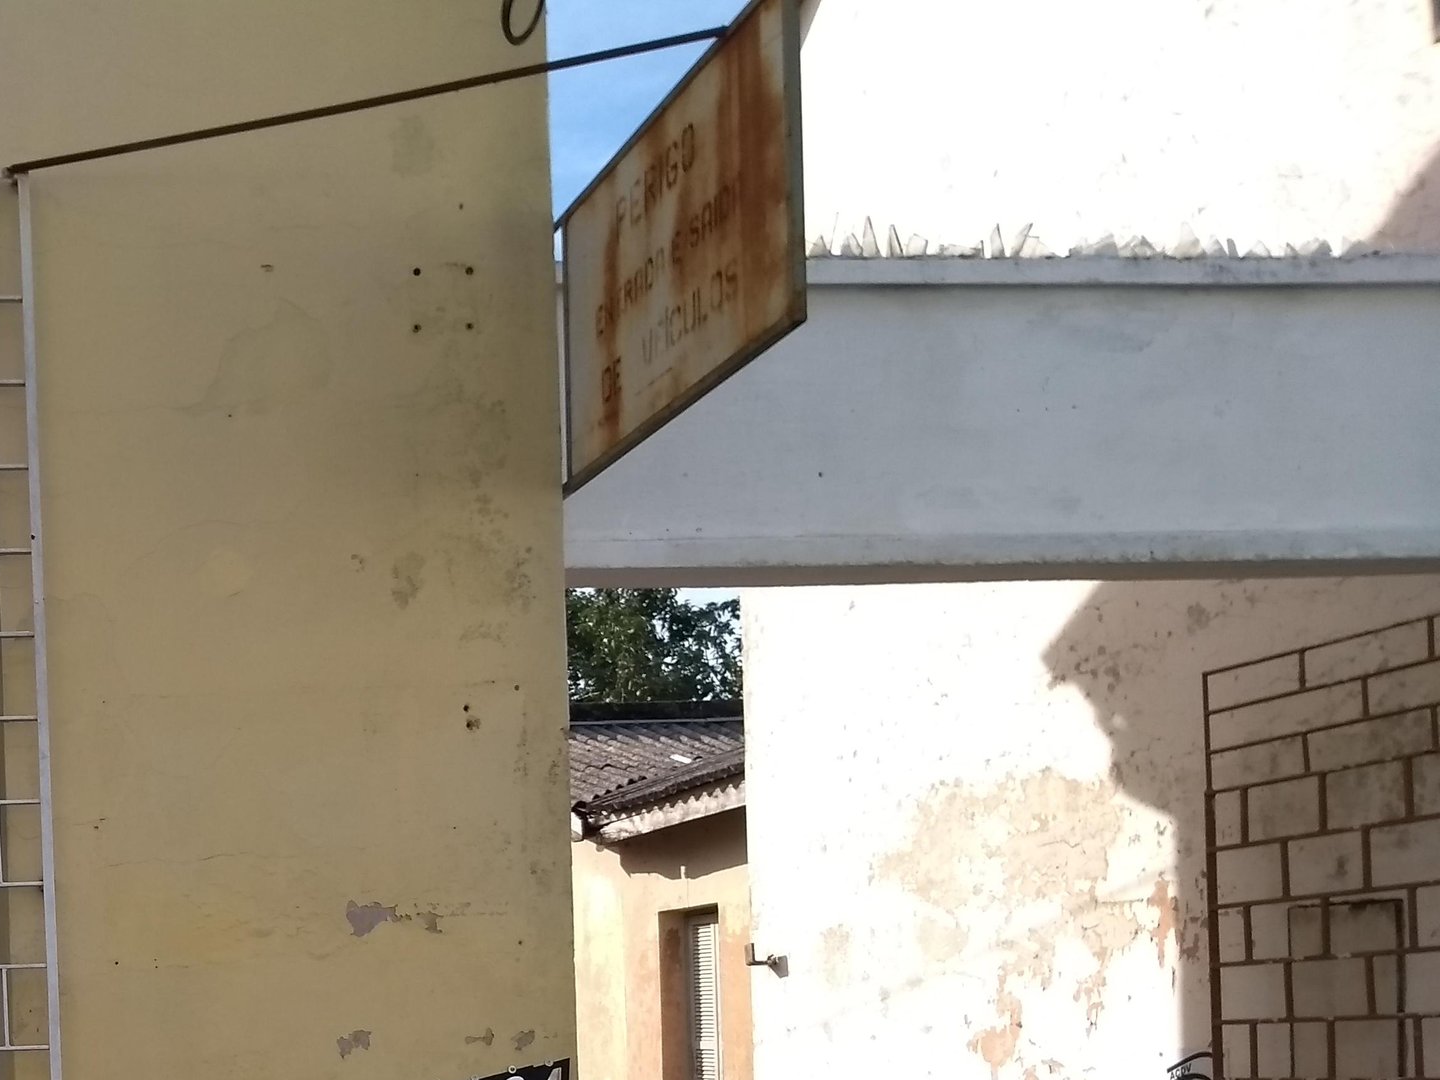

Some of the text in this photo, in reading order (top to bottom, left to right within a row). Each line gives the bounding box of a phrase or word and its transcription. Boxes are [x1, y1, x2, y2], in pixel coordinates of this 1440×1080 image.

[615, 122, 696, 238] PERIGO
[601, 355, 623, 403] DE
[1169, 1062, 1193, 1080] ACDV
